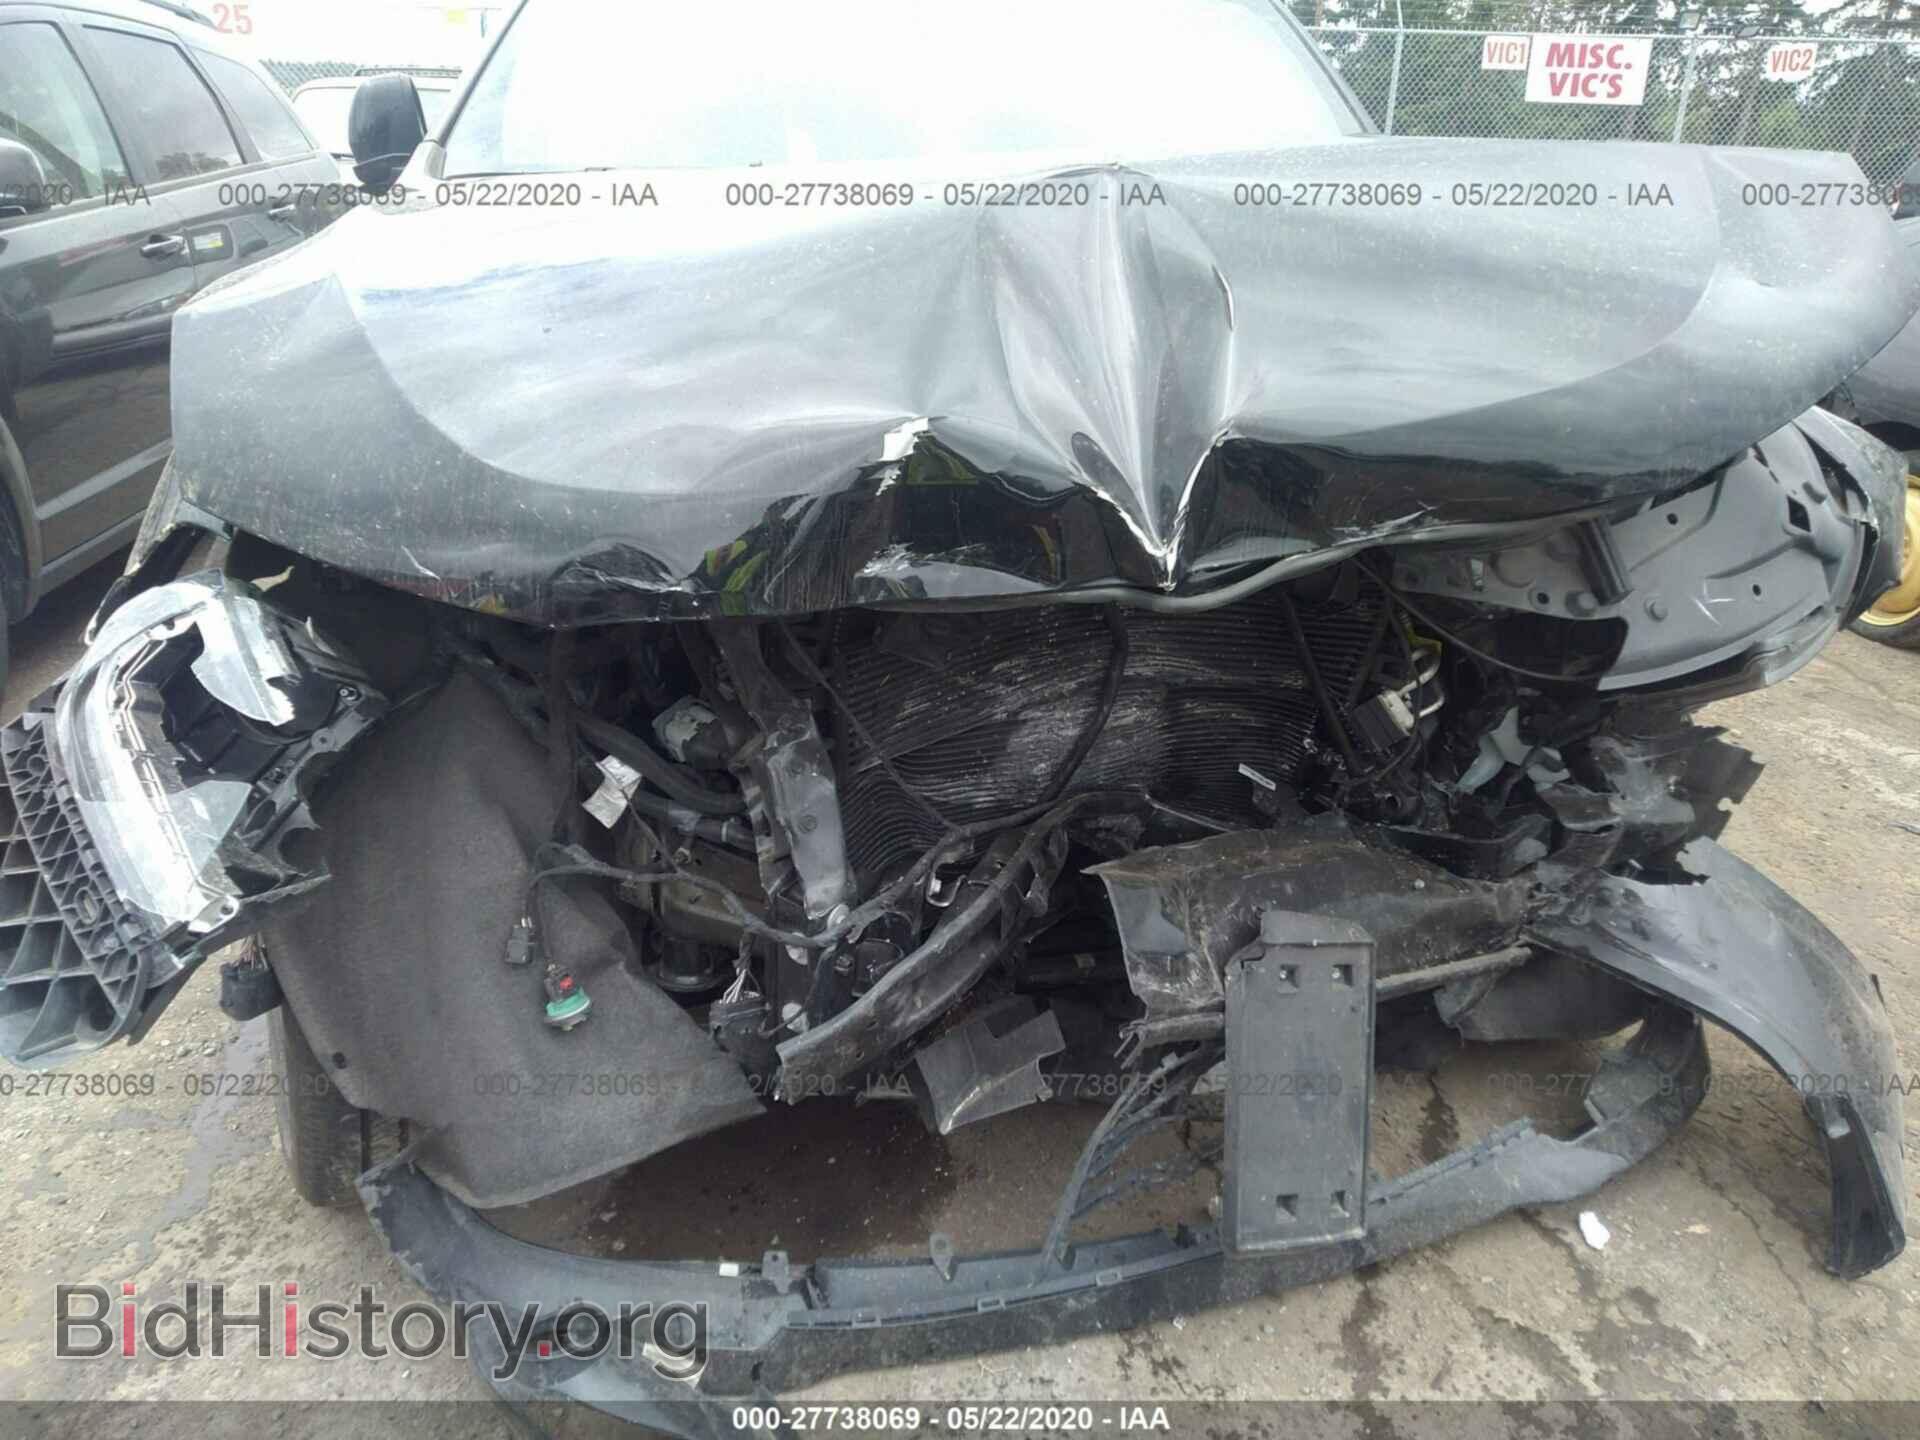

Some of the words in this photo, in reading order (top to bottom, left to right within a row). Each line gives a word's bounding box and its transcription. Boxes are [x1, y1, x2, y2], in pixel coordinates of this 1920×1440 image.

[212, 4, 253, 34] 25
[1486, 41, 1525, 64] VIC1
[1545, 42, 1633, 70] MISC.
[1771, 48, 1813, 72] VIC2
[1549, 73, 1623, 99] VIC'S
